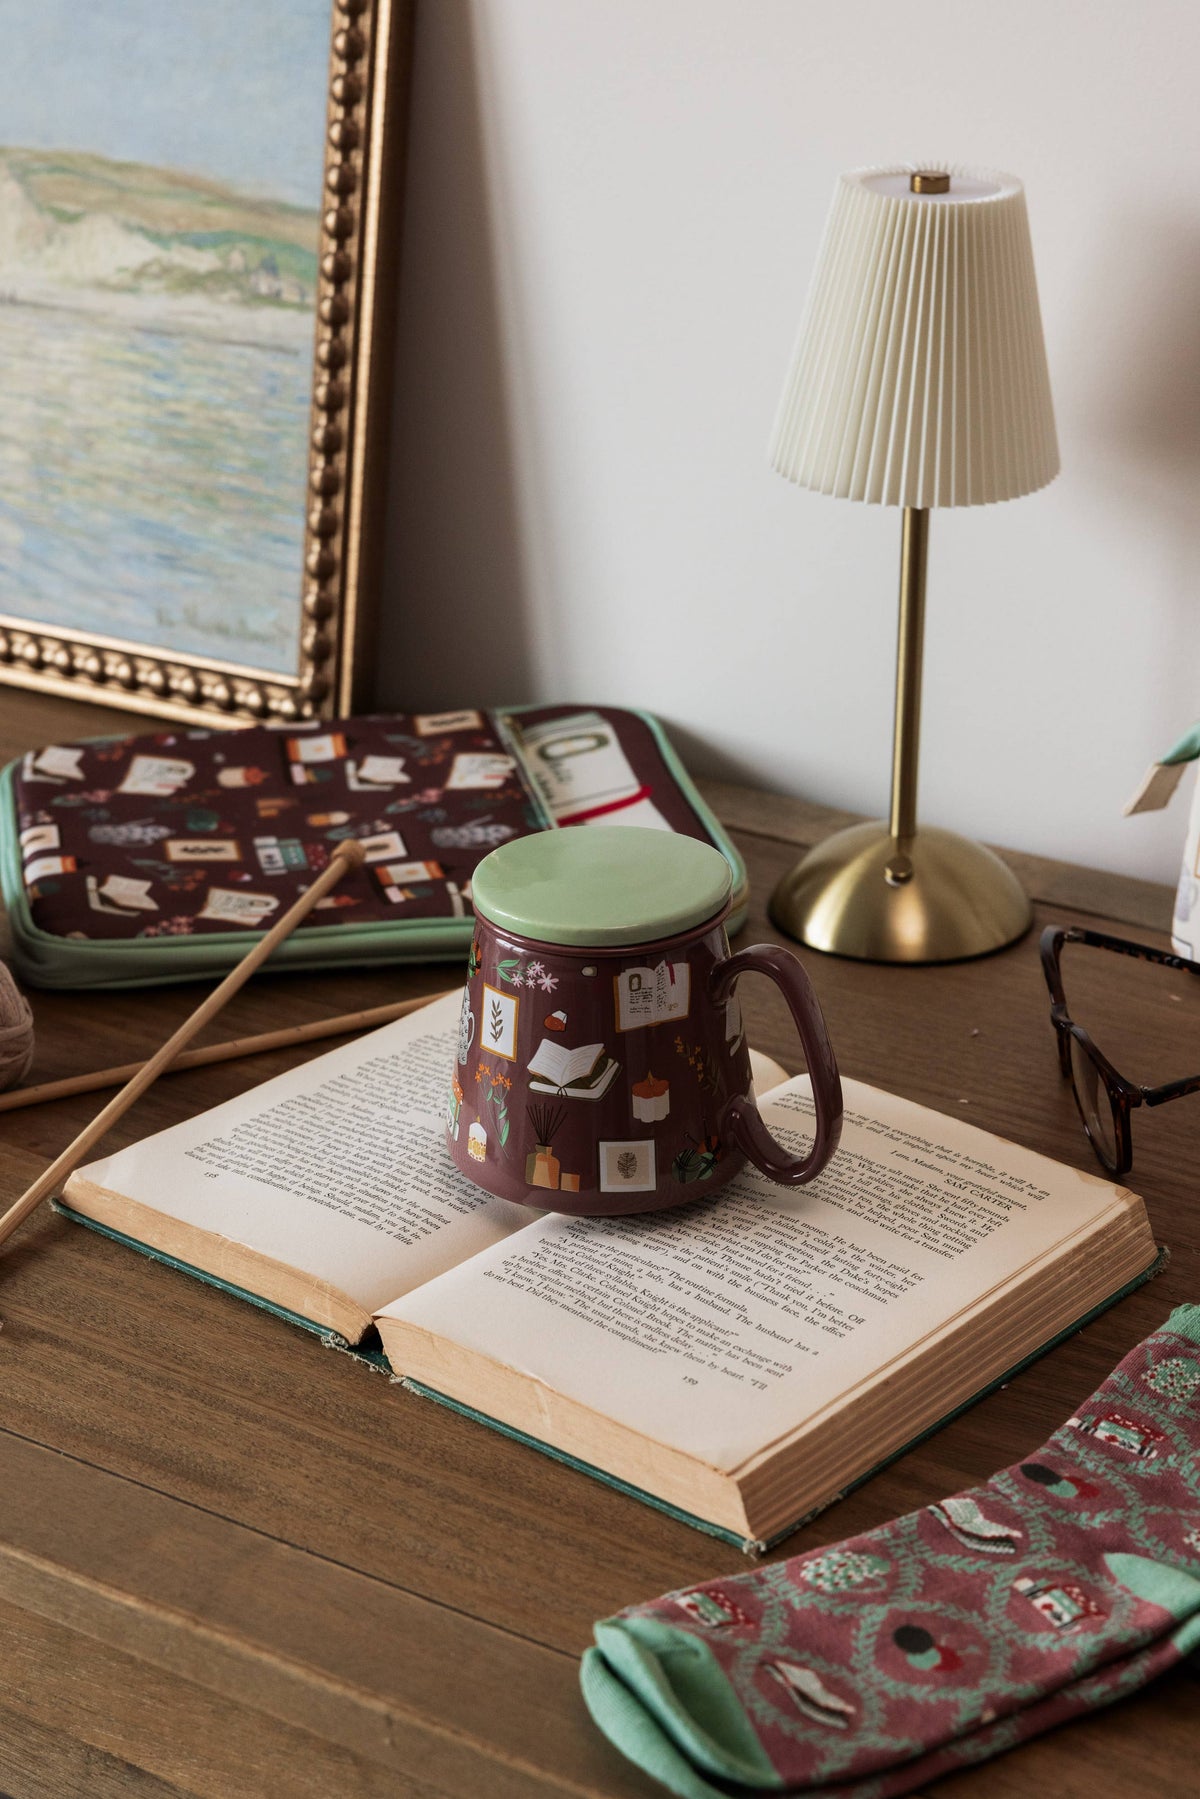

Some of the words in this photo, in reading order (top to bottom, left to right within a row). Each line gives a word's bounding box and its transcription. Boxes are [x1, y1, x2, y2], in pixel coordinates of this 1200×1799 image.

[797, 1189, 821, 1199] settle
[846, 1208, 865, 1217] and
[863, 1215, 879, 1224] not
[879, 1222, 901, 1235] write
[900, 1232, 915, 1241] for
[813, 1178, 829, 1186] two
[828, 1184, 859, 1199] pound
[876, 1203, 891, 1213] the
[892, 1211, 917, 1224] whole
[918, 1222, 941, 1236] thing
[942, 1233, 972, 1250] totting
[844, 1165, 859, 1173] for
[897, 1188, 913, 1196] she
[914, 1195, 942, 1209] always
[943, 1206, 967, 1219] knew
[856, 1177, 872, 1187] bill
[873, 1185, 887, 1193] for
[887, 1191, 902, 1200] his
[937, 1213, 968, 1229] Swords
[969, 1228, 989, 1238] and
[857, 1162, 881, 1175] What
[887, 1176, 920, 1191] mistake
[920, 1189, 938, 1199] that
[950, 1201, 969, 1212] had
[968, 1210, 989, 1220] ever
[986, 1217, 1003, 1227] left
[887, 1168, 903, 1176] salt
[925, 1183, 943, 1192] She
[942, 1191, 961, 1200] sent
[960, 1198, 979, 1208] fifty
[977, 1206, 1010, 1222] pounds
[943, 1179, 968, 1191] SAM
[969, 1189, 1012, 1211] CARTER
[779, 1214, 800, 1224] want
[847, 1243, 867, 1254] had
[866, 1251, 887, 1265] been
[887, 1263, 911, 1275] paid
[910, 1272, 925, 1281] for
[525, 1286, 545, 1297] Did
[541, 1294, 561, 1305] they
[559, 1303, 594, 1323] mention
[593, 1320, 609, 1329] the
[567, 1242, 599, 1254] patient
[667, 1281, 684, 1292] has
[735, 1313, 753, 1326] The
[755, 1323, 794, 1344] husband
[794, 1341, 810, 1352] has
[668, 1270, 686, 1282] The
[684, 1279, 715, 1296] routine
[727, 1278, 742, 1288] the
[744, 1286, 779, 1307] business
[804, 1316, 820, 1326] the
[821, 1325, 846, 1338] office
[517, 1255, 548, 1270] brother
[582, 1283, 611, 1300] certain
[612, 1297, 647, 1316] Colonel
[677, 1327, 694, 1339] The
[694, 1338, 724, 1353] matter
[724, 1350, 741, 1360] has
[742, 1357, 763, 1369] been
[764, 1368, 785, 1378] sent
[599, 1280, 633, 1298] Colonel
[631, 1295, 661, 1312] Knight
[660, 1309, 686, 1325] hopes
[696, 1328, 720, 1341] make
[732, 1345, 772, 1363] exchange
[773, 1361, 793, 1372] with
[681, 1375, 699, 1386] 159
